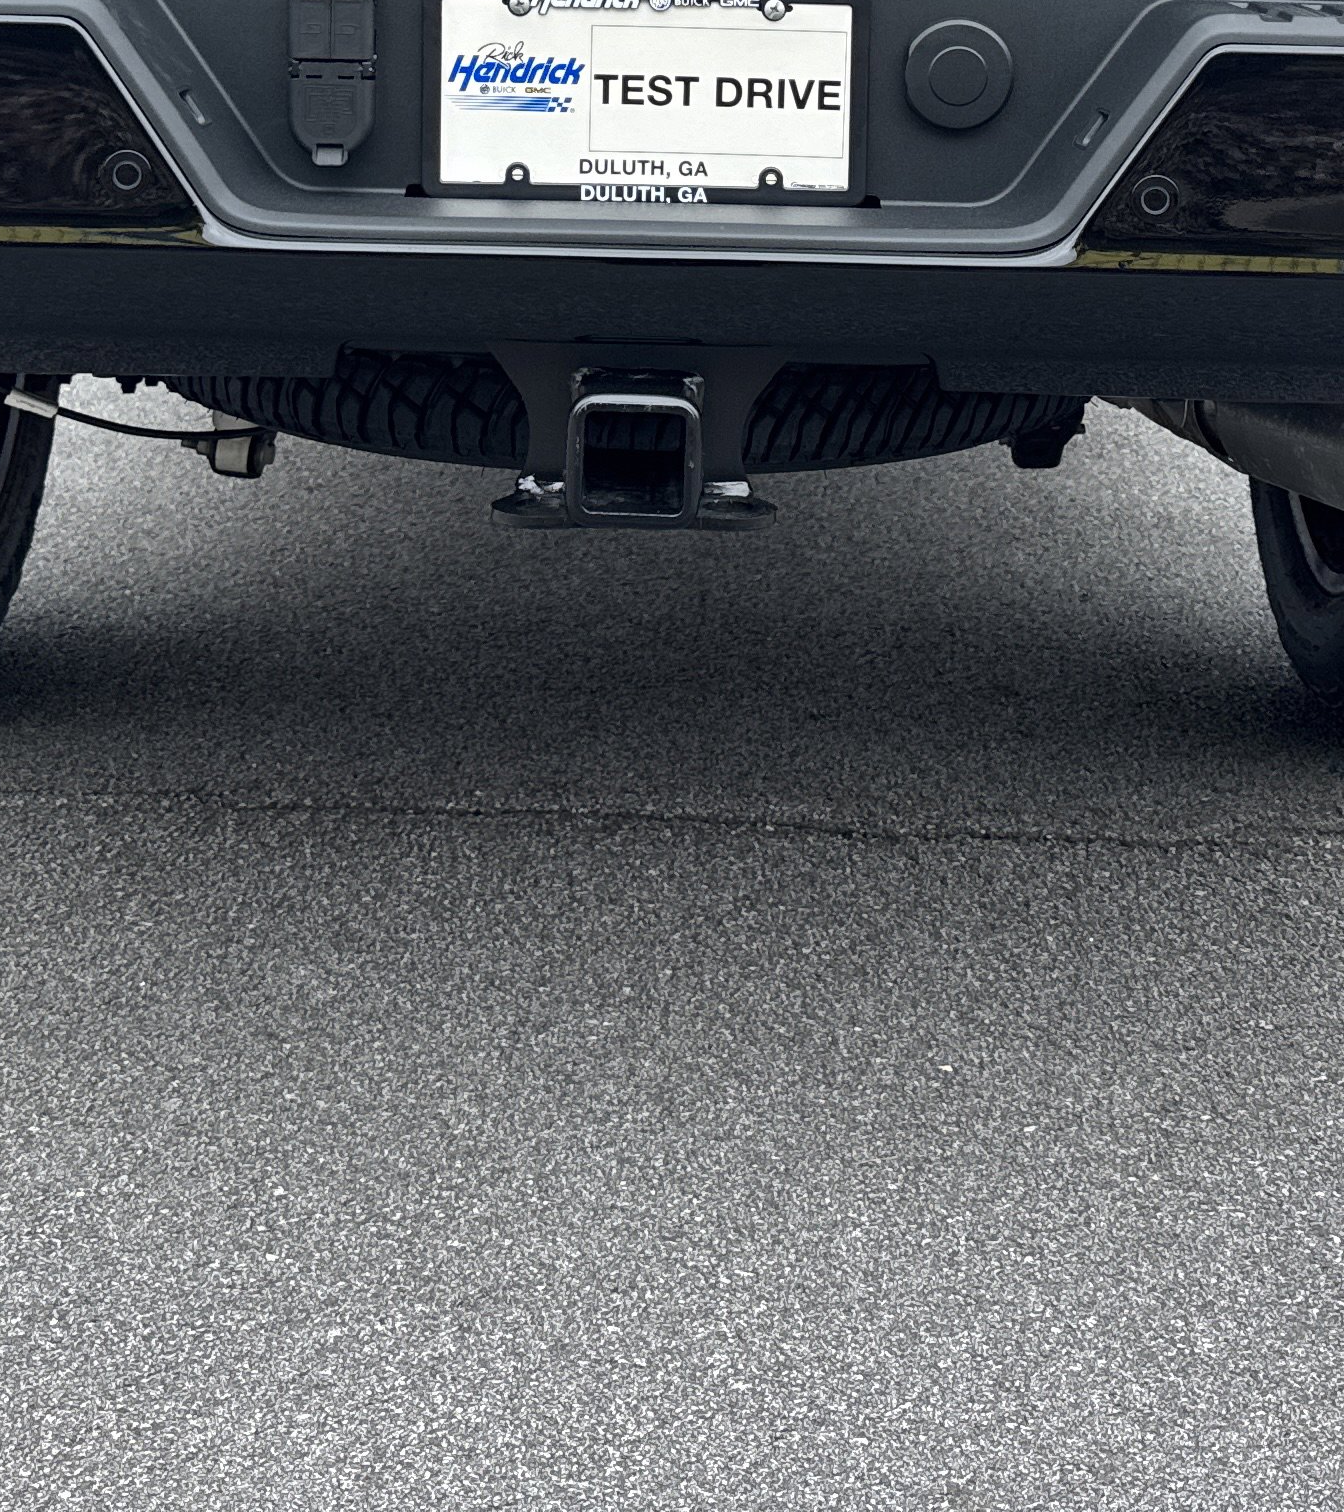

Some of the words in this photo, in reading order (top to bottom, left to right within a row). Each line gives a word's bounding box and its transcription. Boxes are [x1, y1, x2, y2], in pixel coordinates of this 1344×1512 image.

[477, 40, 524, 66] Rick
[447, 54, 586, 92] Hendrick
[492, 85, 517, 94] BUICK
[593, 73, 699, 107] TEST
[715, 77, 842, 111] DRIVE
[579, 158, 671, 179] DULUTH,
[678, 160, 708, 177] GA
[580, 184, 671, 204] DULUTH,
[677, 186, 708, 203] GA
